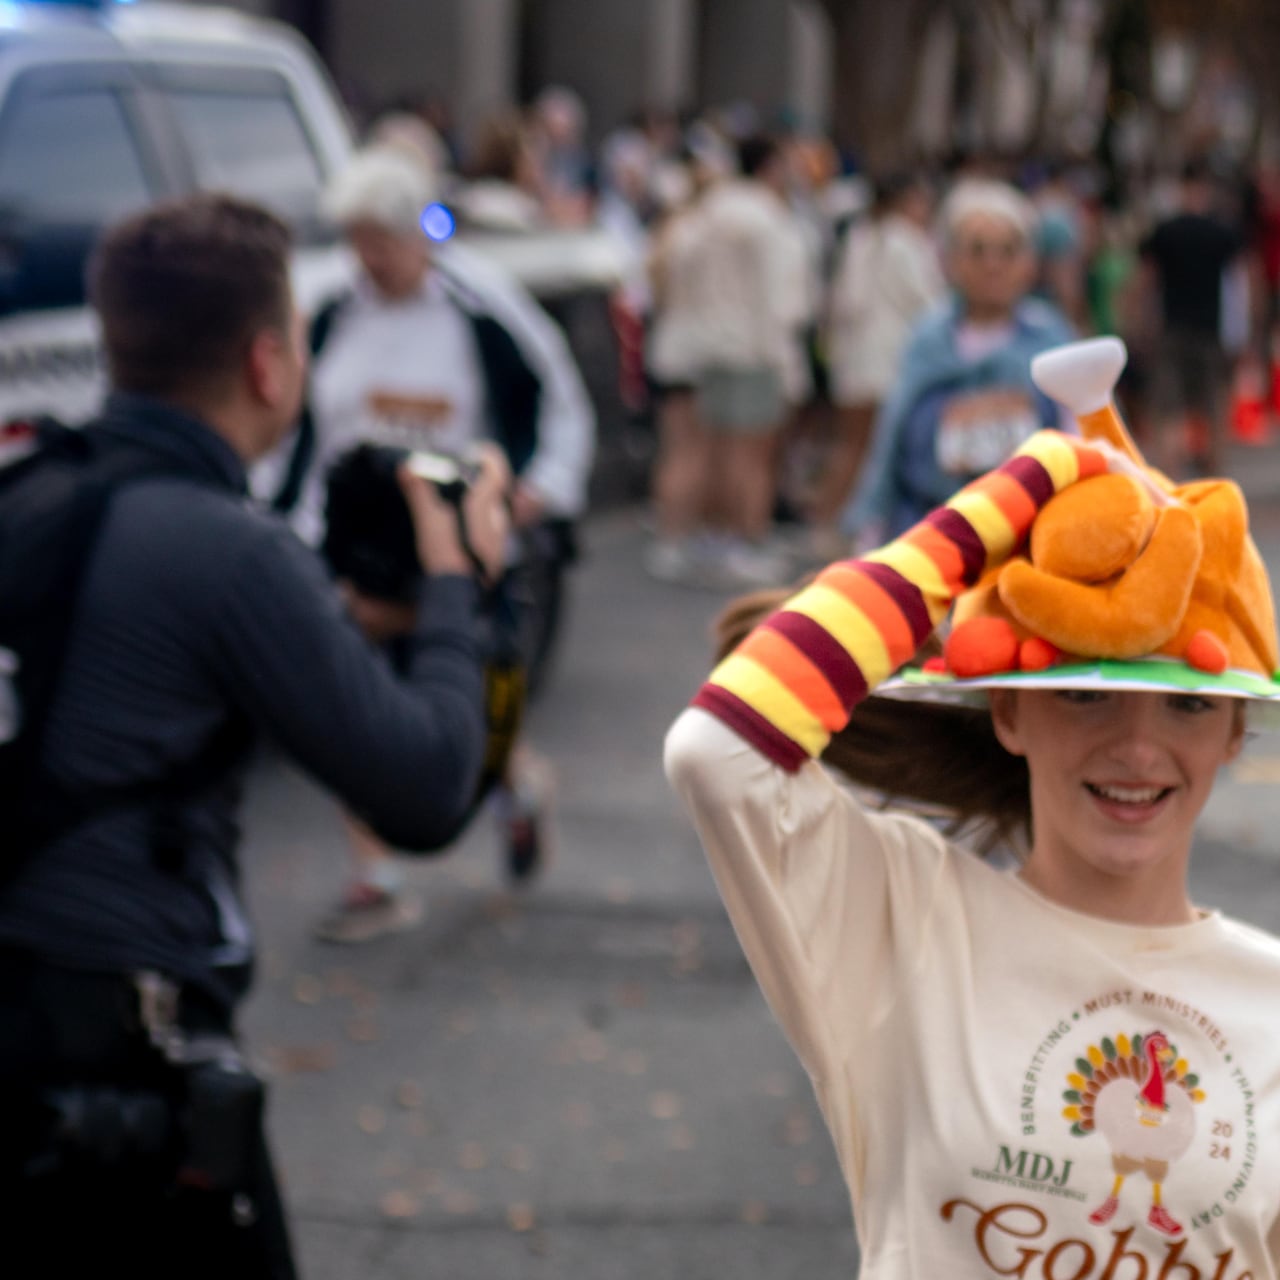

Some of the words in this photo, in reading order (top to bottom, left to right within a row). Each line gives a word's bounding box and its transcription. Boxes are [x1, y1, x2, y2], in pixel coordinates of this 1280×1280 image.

[1020, 1021, 1072, 1136] BENEFITTING
[1084, 991, 1132, 1016] MUST
[1142, 992, 1228, 1050] MINISTRIES
[1191, 1203, 1224, 1230] DAY
[1211, 1120, 1234, 1138] 20
[993, 1145, 1074, 1187] MDJ
[1209, 1143, 1231, 1160] 24
